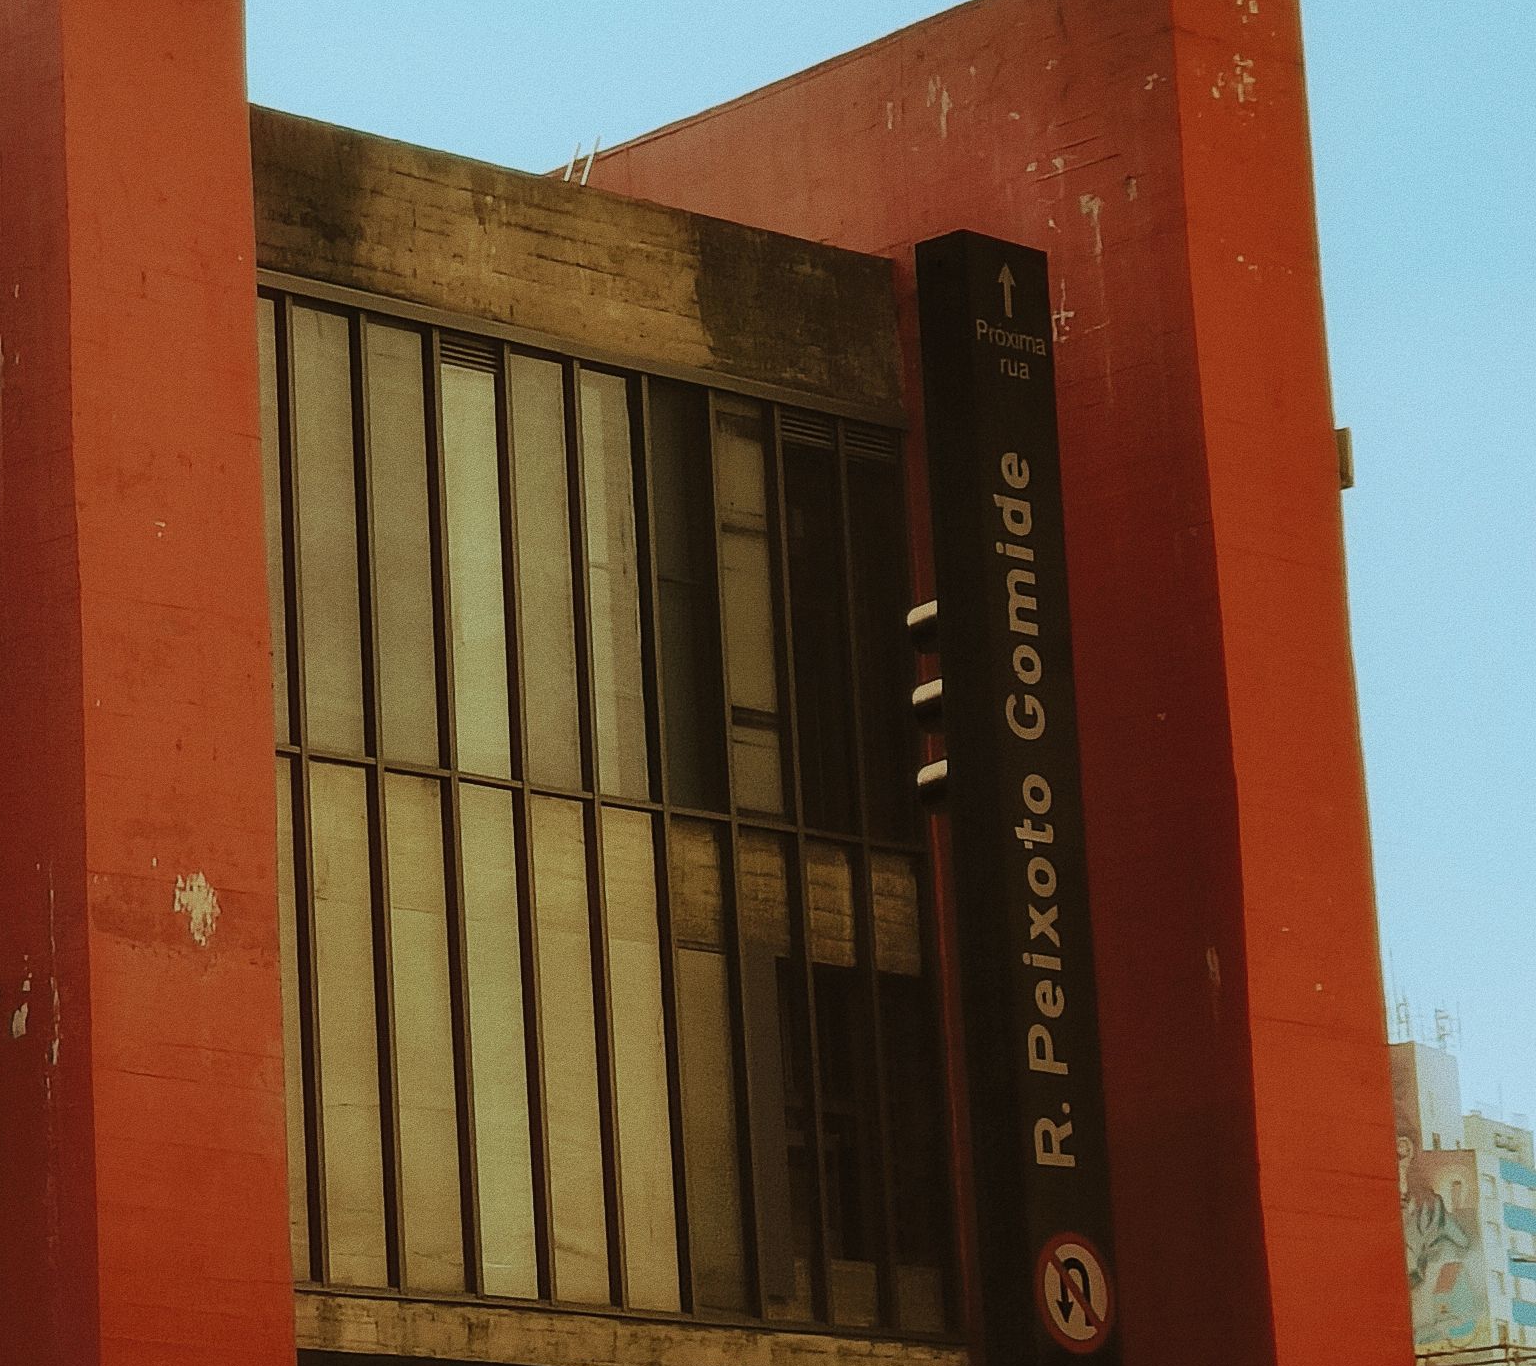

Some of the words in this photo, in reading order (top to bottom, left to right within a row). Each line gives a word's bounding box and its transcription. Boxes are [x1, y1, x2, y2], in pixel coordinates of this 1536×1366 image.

[976, 318, 1046, 355] Próxima
[1000, 357, 1030, 379] rua
[992, 451, 1046, 741] Gomide
[1014, 773, 1069, 1076] Peixoto
[1032, 1102, 1076, 1168] R.
